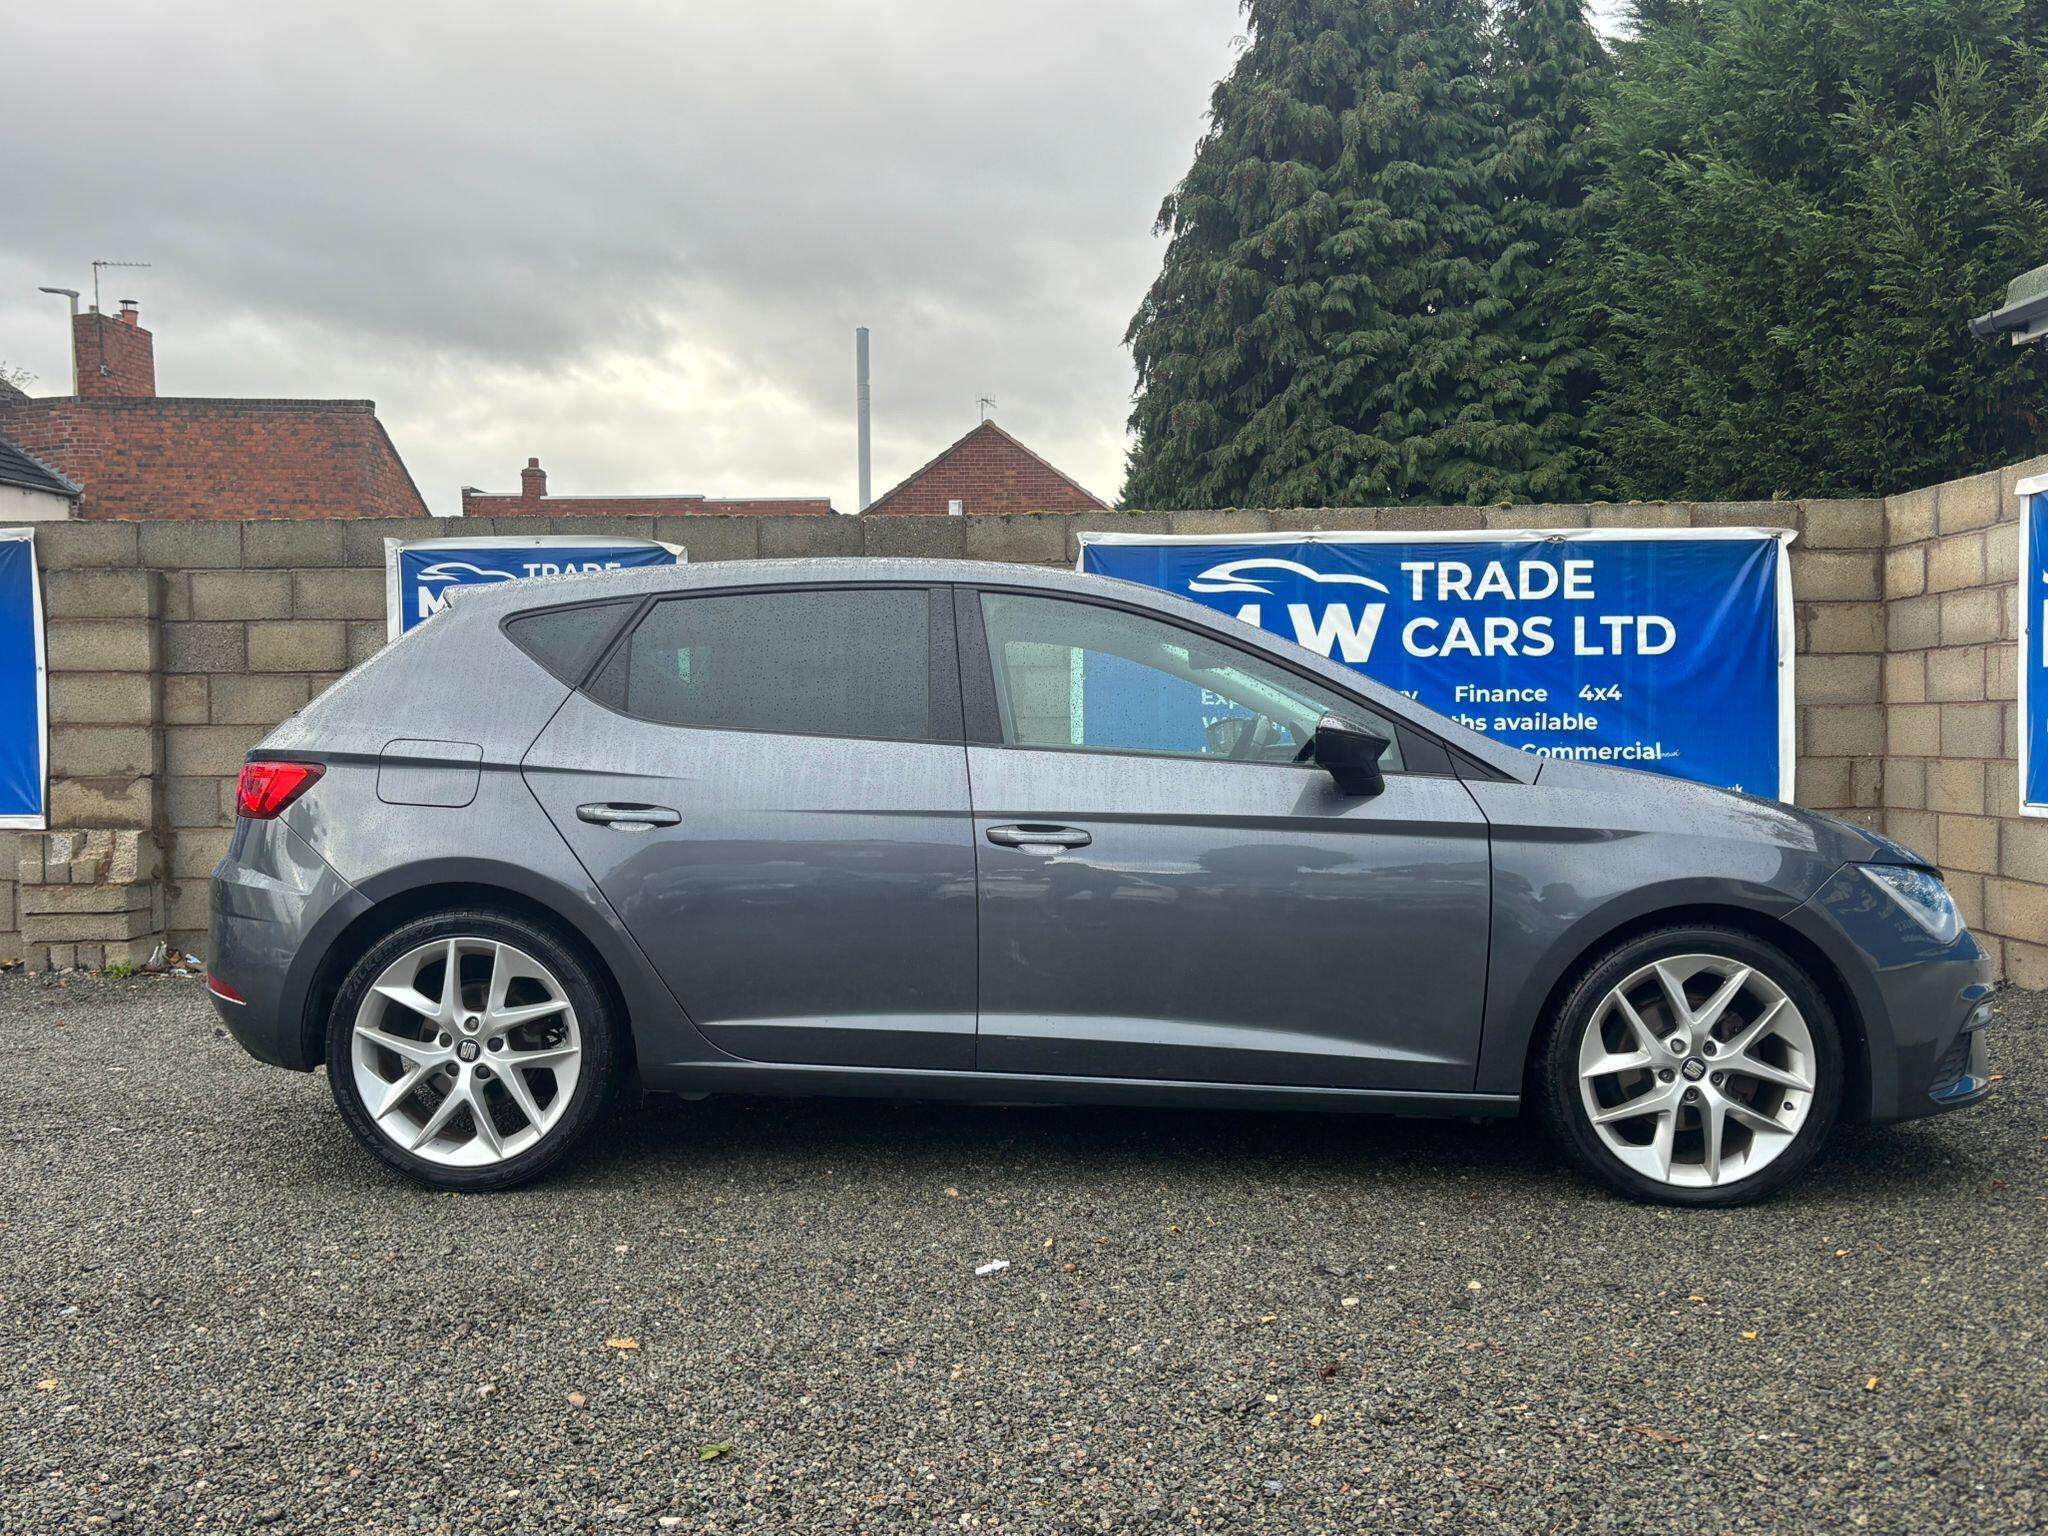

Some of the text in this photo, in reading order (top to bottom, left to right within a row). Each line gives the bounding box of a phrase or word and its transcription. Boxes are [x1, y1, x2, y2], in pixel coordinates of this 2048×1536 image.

[1401, 560, 1595, 601] TRADE
[1402, 615, 1677, 658] CARS LTD
[1455, 684, 1623, 703] Finance 4x4
[1494, 712, 1598, 731] available
